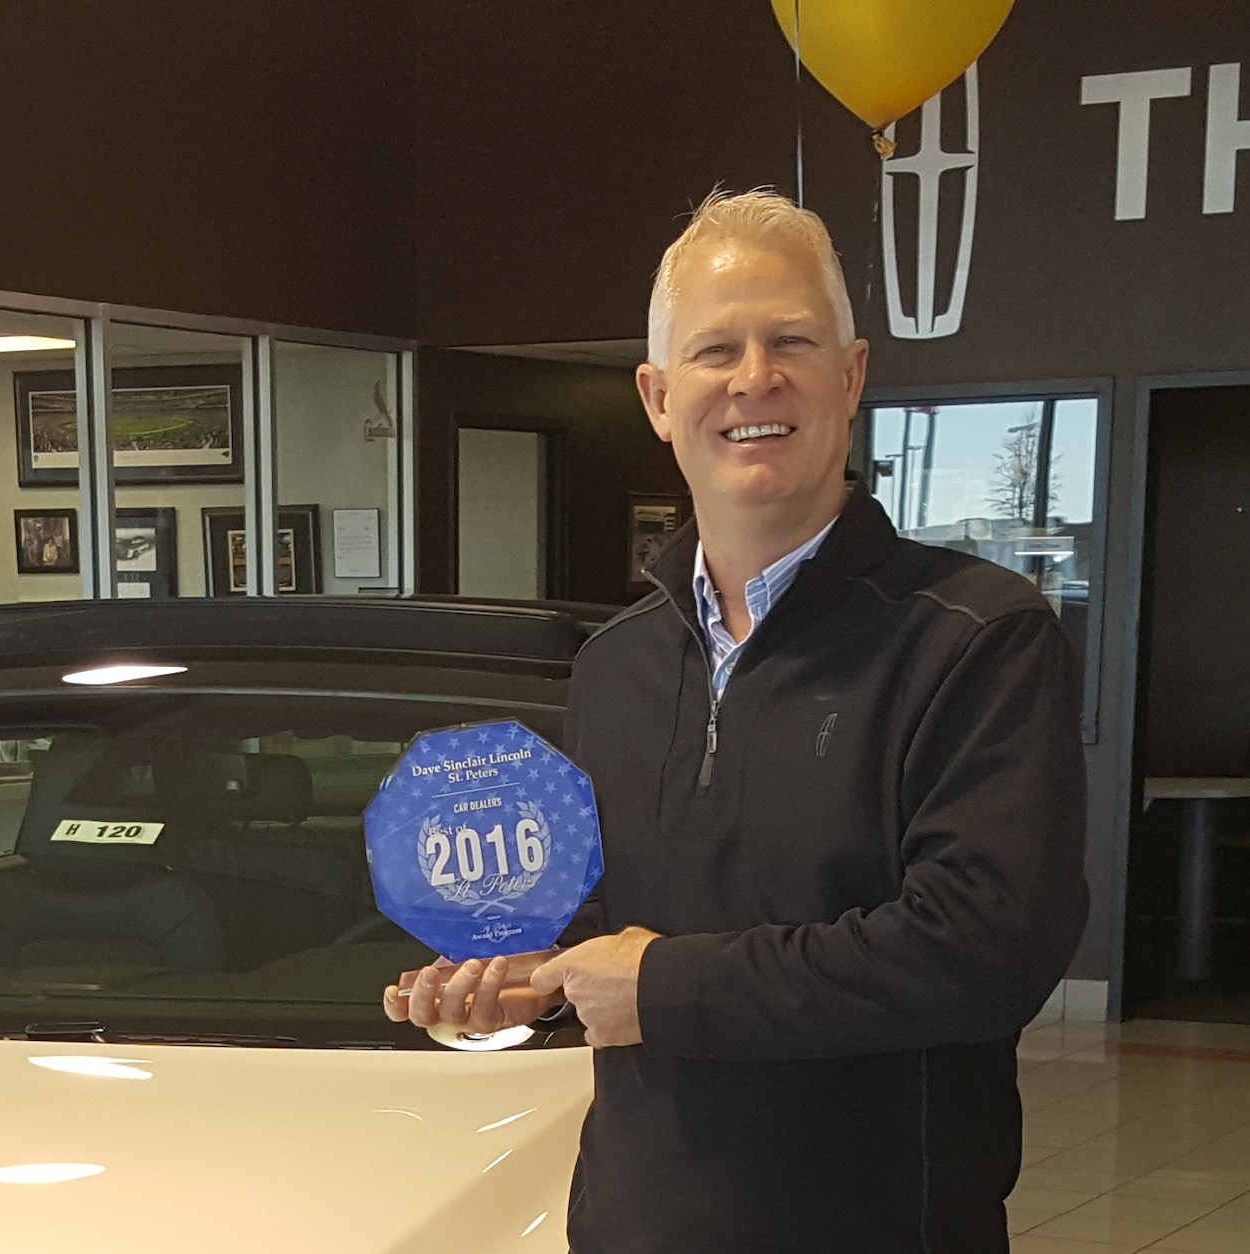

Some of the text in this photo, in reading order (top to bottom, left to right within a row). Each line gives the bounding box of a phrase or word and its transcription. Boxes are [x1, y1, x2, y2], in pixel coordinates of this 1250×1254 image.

[412, 748, 532, 777] Dave Sinclair Lincoln
[448, 767, 499, 784] St. Peters
[453, 797, 502, 814] CAR DEALERS
[65, 823, 142, 838] H 120
[425, 818, 544, 887] 2016
